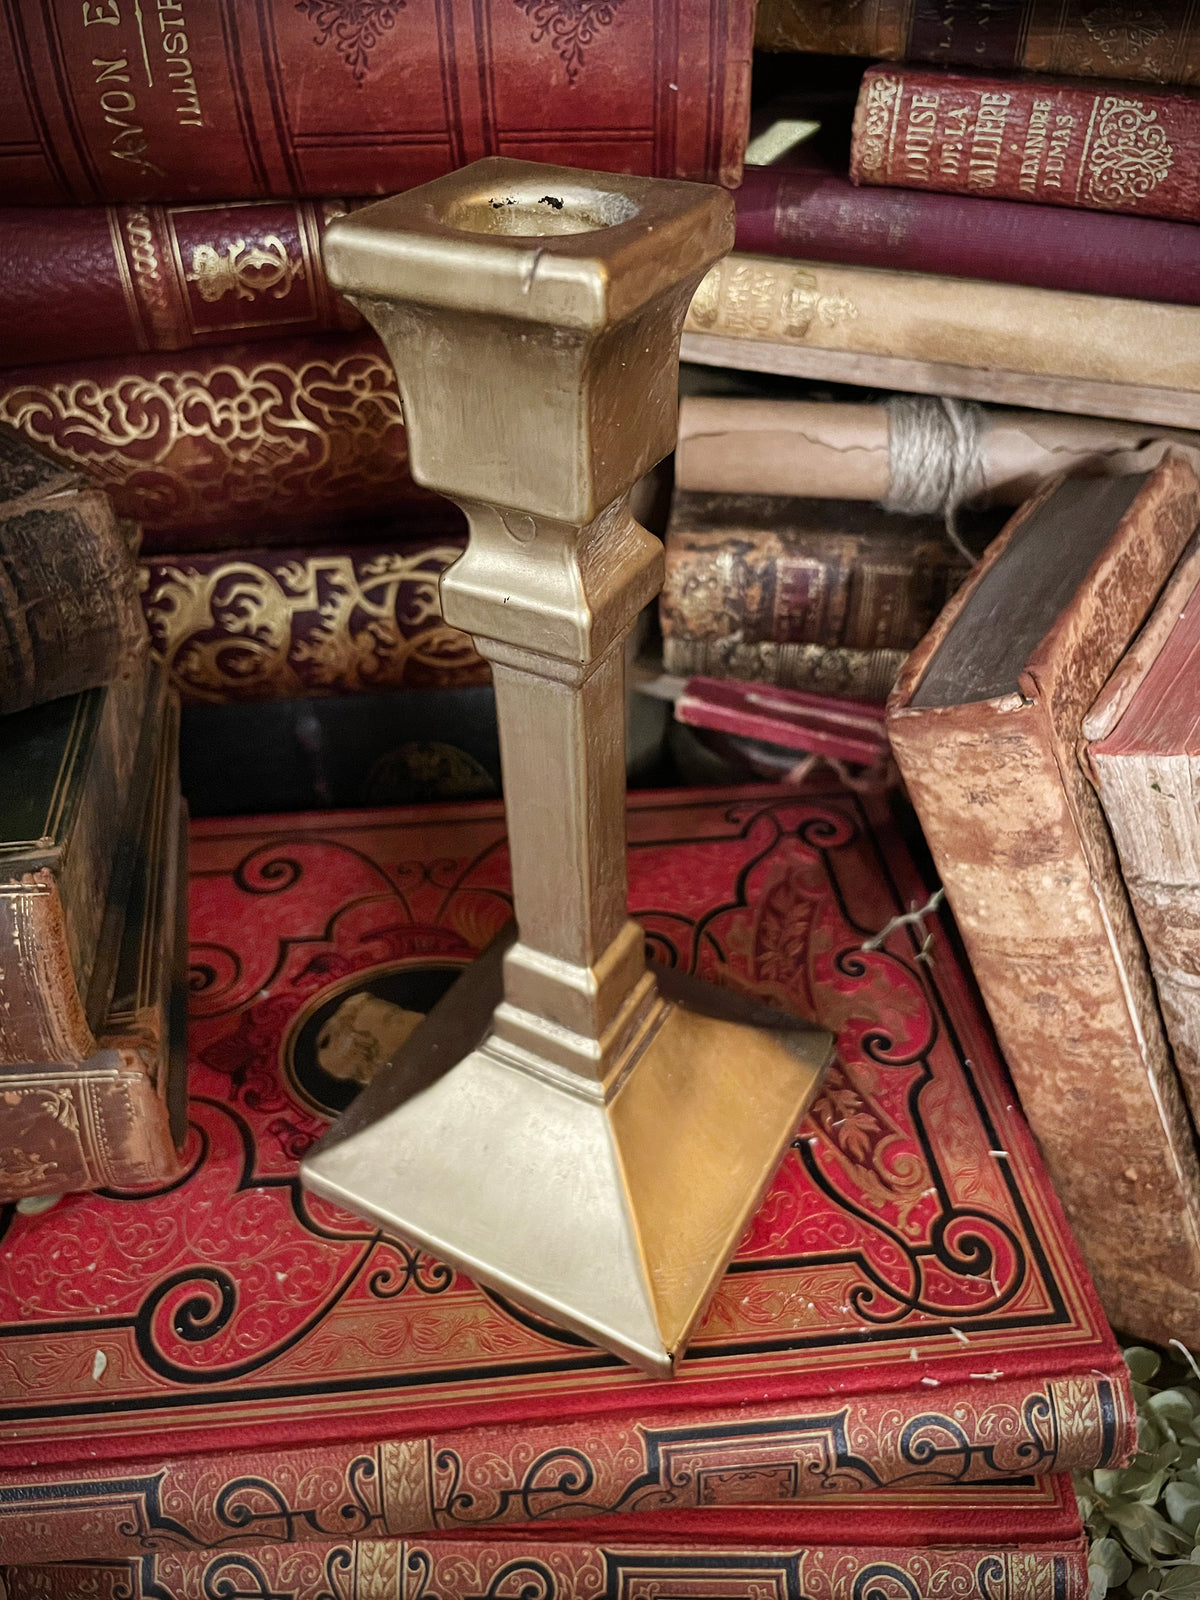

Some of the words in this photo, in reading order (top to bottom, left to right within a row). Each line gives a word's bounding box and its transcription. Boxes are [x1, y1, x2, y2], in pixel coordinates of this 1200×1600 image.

[92, 58, 167, 178] AVON
[904, 94, 940, 181] LOUISE
[944, 105, 970, 138] LA
[1019, 99, 1052, 194] ALEXANDRE
[1043, 113, 1074, 188] DUMAS
